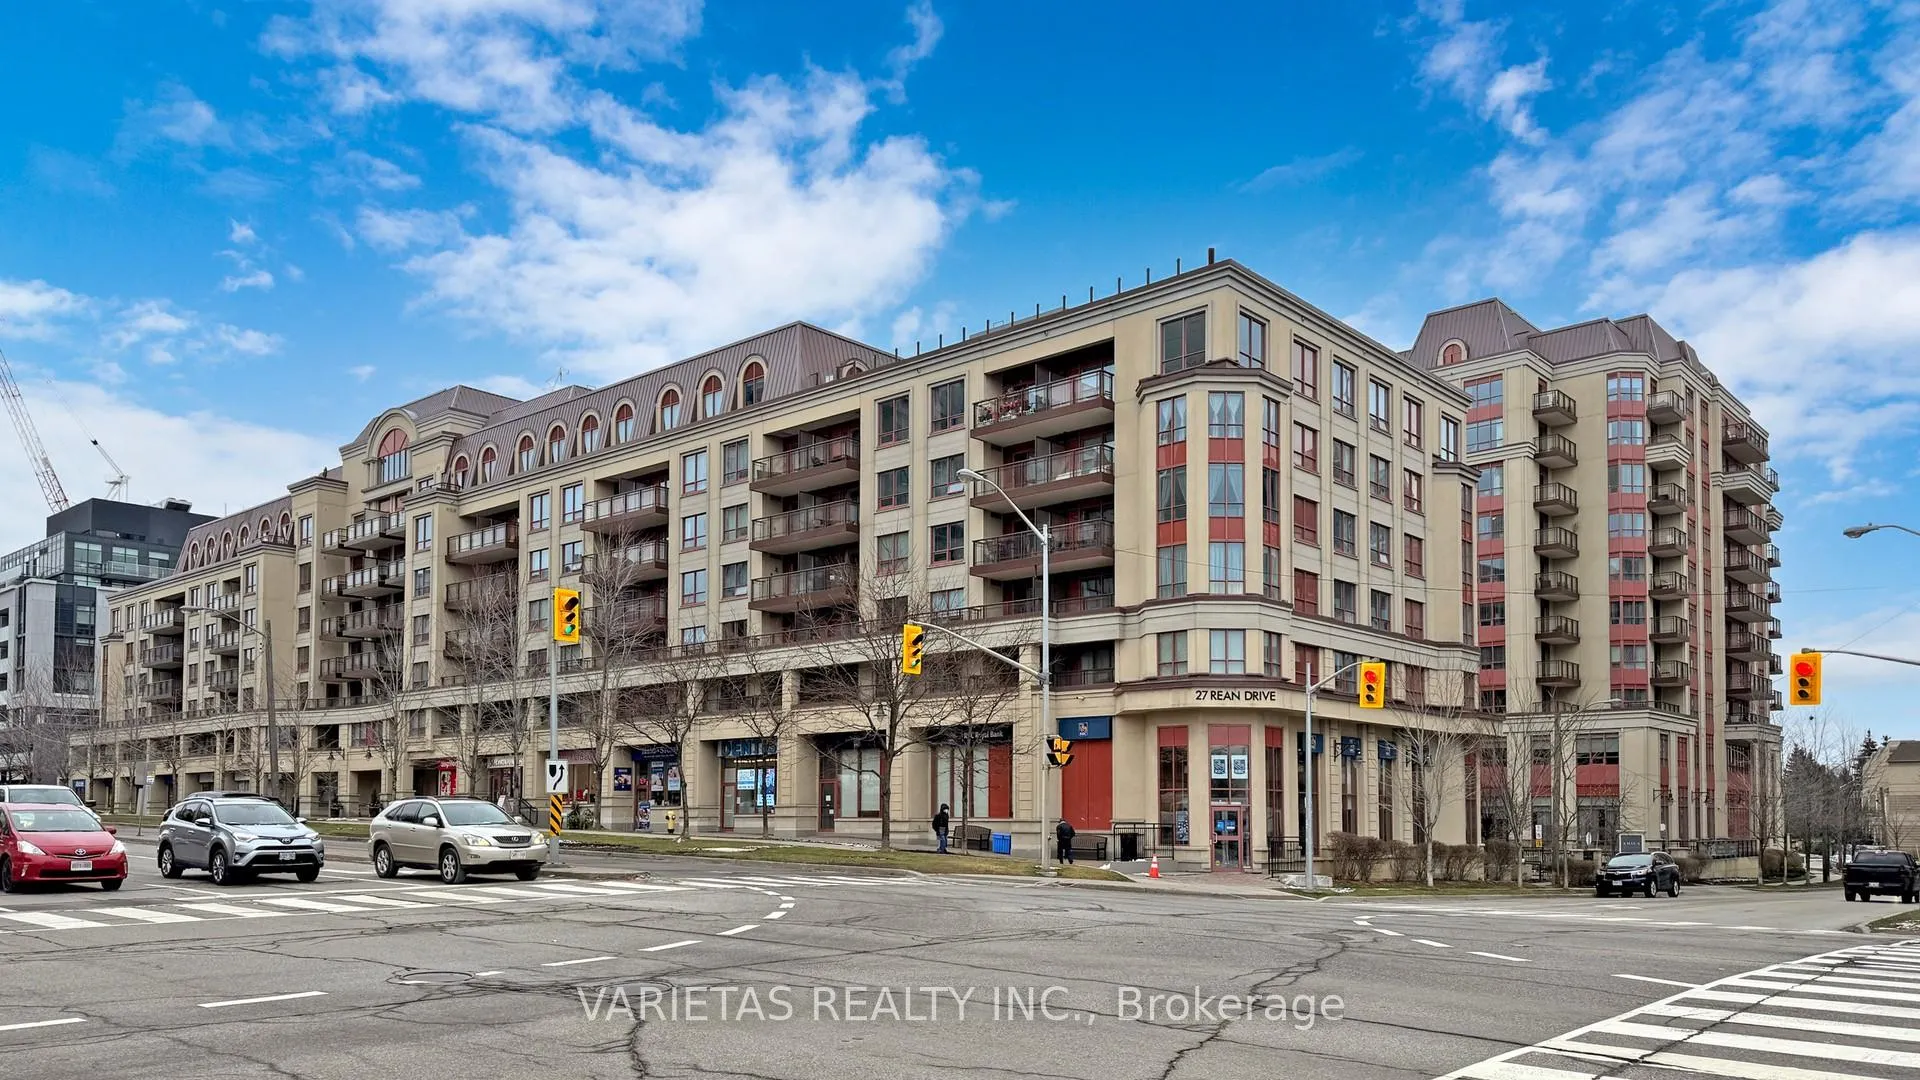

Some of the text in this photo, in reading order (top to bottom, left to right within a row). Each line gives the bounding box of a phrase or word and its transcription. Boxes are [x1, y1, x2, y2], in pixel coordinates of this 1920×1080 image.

[1195, 690, 1276, 702] 27 REAN DRIVE
